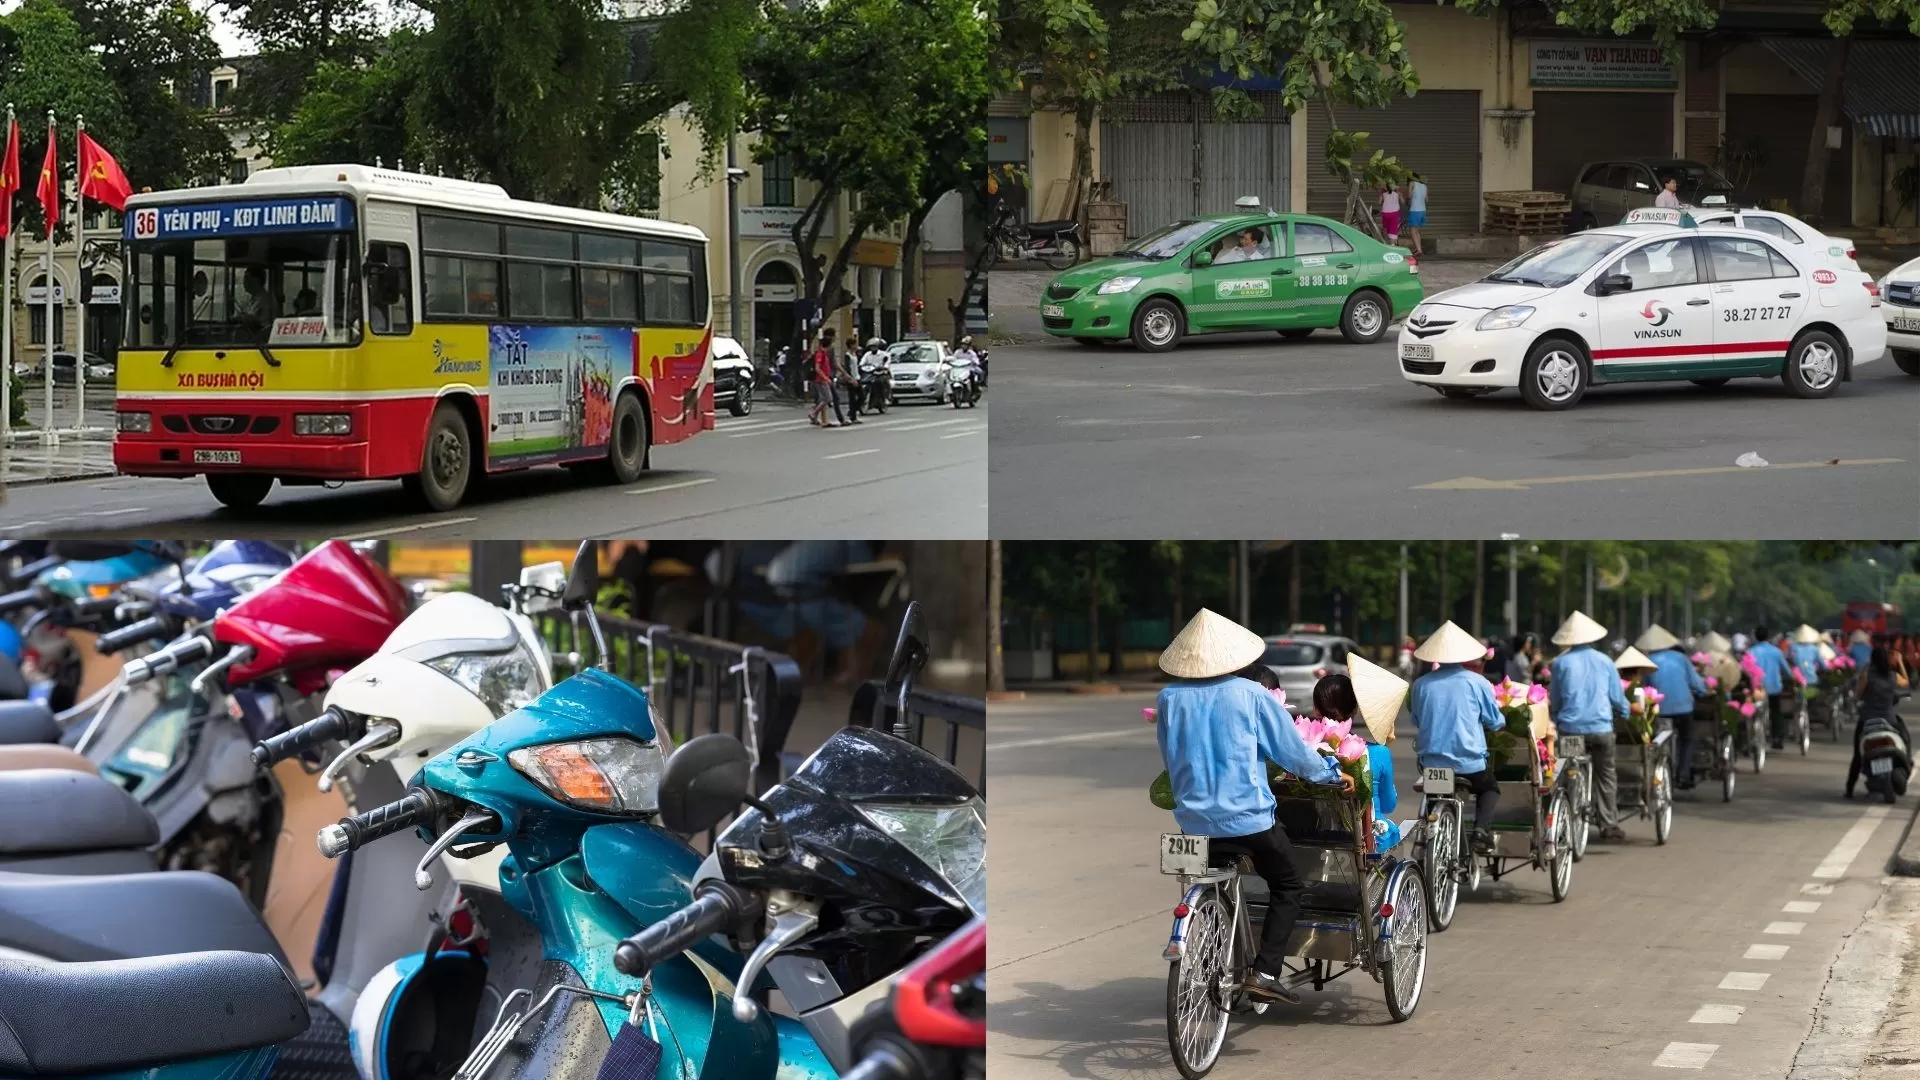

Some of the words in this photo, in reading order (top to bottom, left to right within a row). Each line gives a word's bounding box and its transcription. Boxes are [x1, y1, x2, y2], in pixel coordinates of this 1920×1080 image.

[136, 212, 156, 235] 36
[163, 209, 189, 232] YÊN
[193, 209, 221, 232] PHỤ
[233, 207, 261, 228] KĐT
[264, 205, 297, 226] LINH
[300, 200, 336, 224] ĐÀM
[1641, 212, 1668, 221] VINASUN
[1299, 275, 1310, 287] 38
[1312, 275, 1323, 286] 38
[1325, 274, 1336, 286] 38
[1337, 274, 1348, 285] 38
[1723, 308, 1757, 322] 38.27
[1760, 307, 1774, 321] 27
[1777, 306, 1791, 320] 27
[277, 319, 299, 335] YÊN
[300, 320, 324, 338] PHỤ
[1634, 329, 1682, 339] VINASUN
[239, 370, 264, 391] NỘI
[1428, 768, 1449, 781] 29XL
[1168, 837, 1199, 856] 29XL
